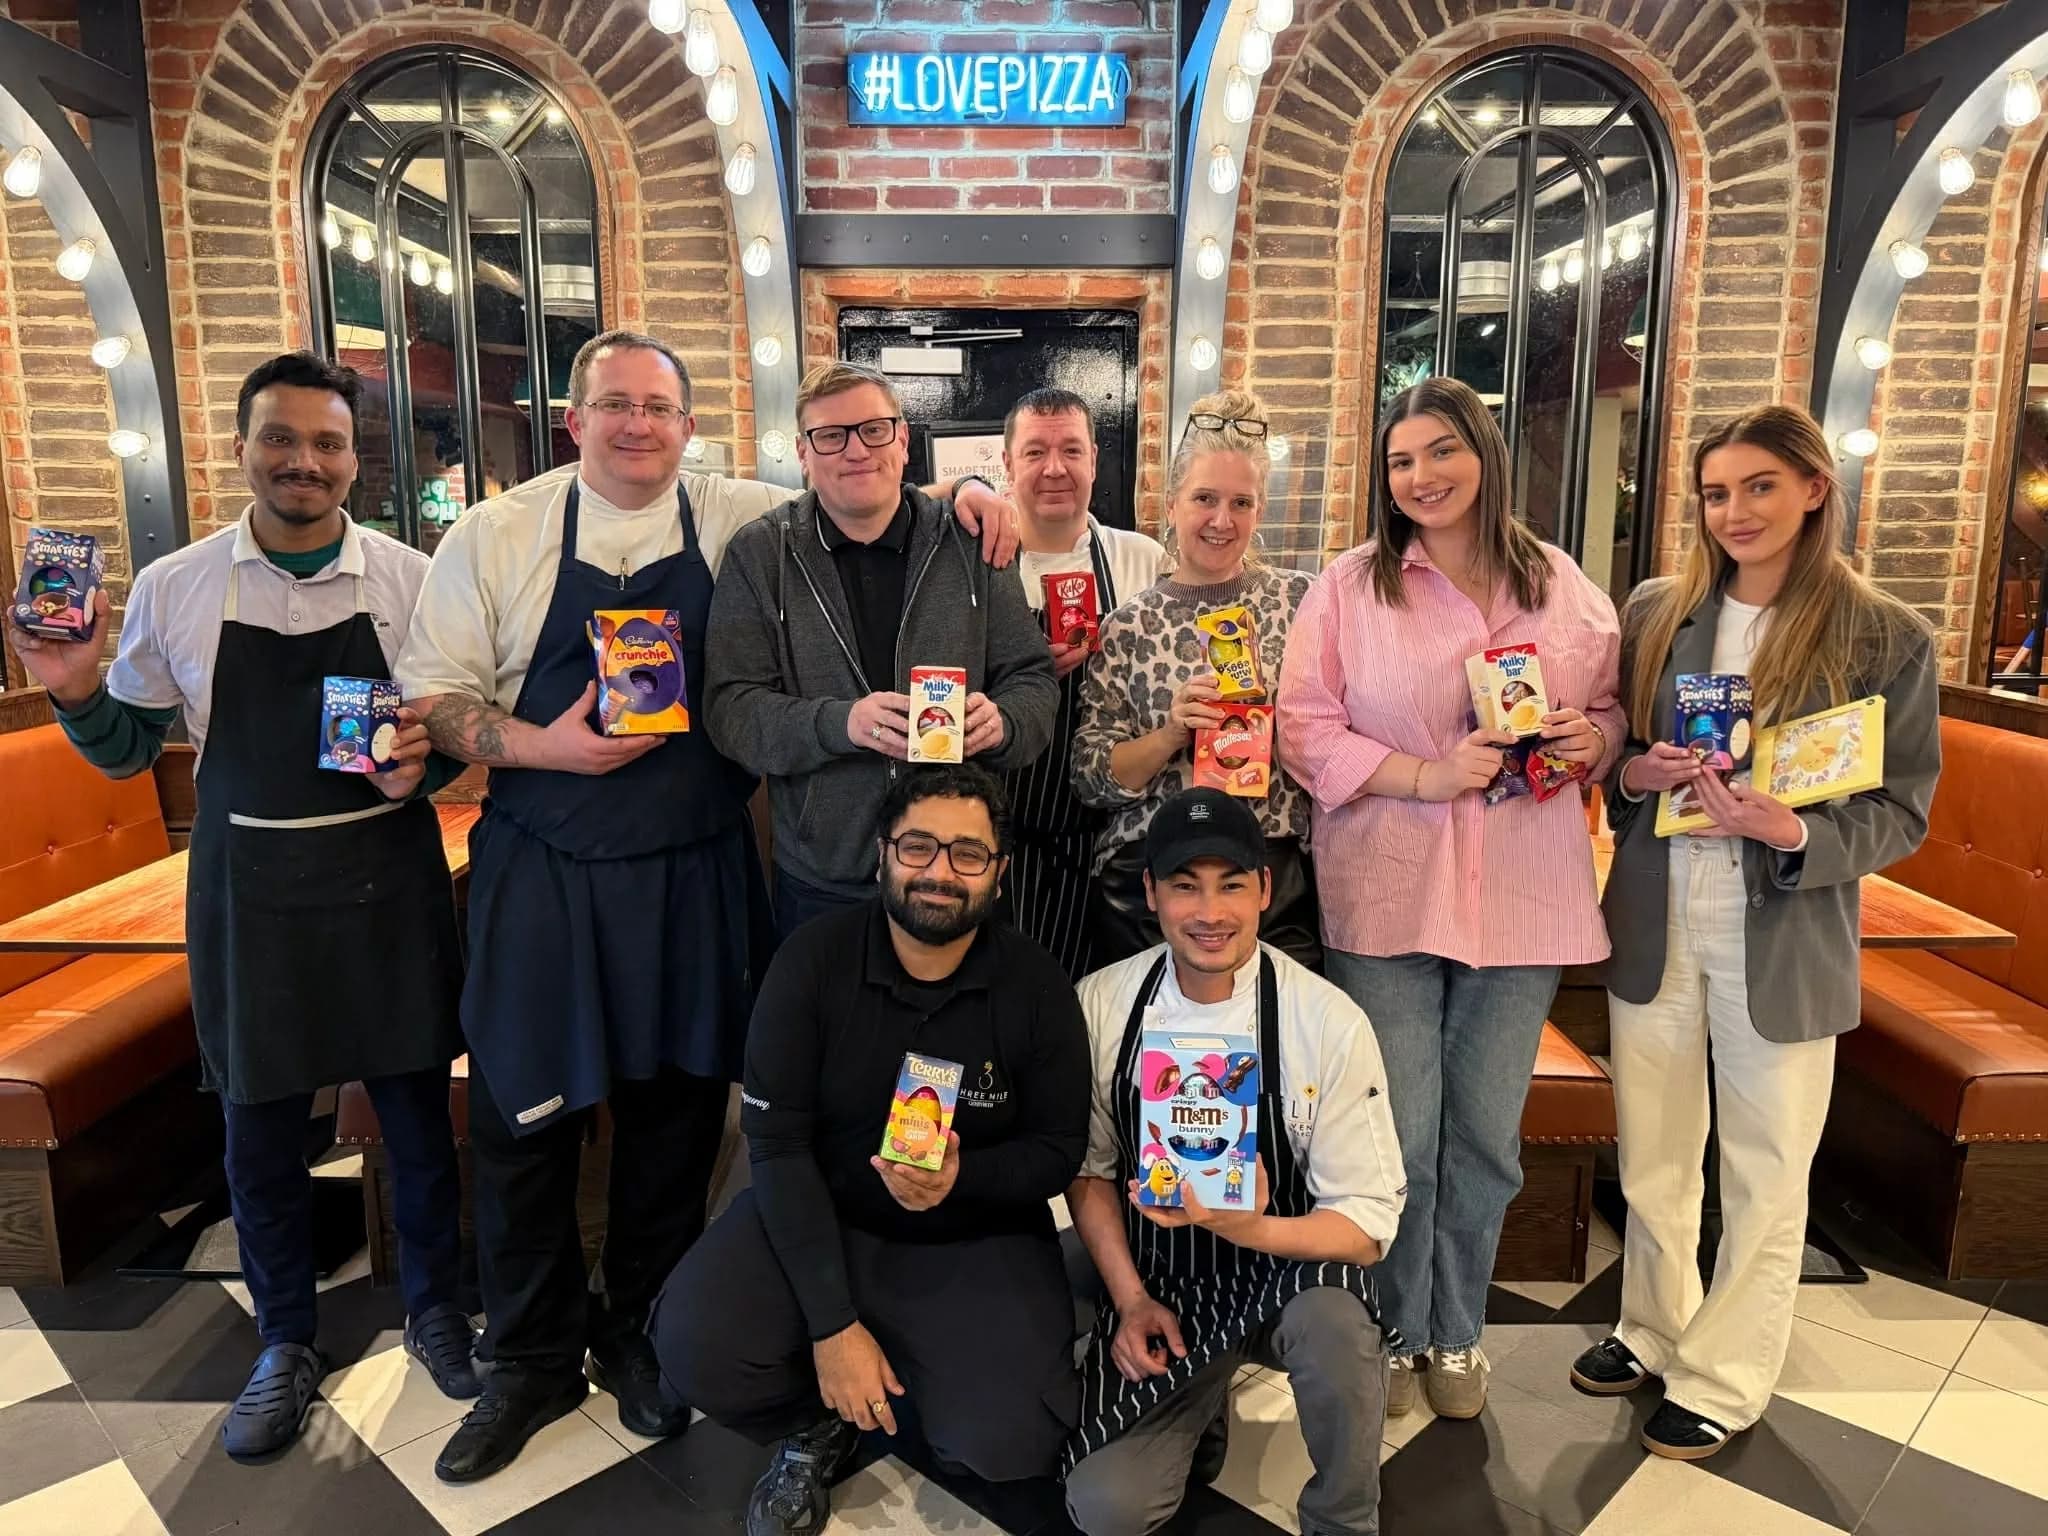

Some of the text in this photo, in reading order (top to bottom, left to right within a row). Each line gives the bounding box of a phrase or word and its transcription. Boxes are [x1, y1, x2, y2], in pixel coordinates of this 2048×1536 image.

[863, 54, 1115, 113] #LOVEPIZZA
[979, 465, 1002, 475] THE
[30, 541, 88, 558] SMARTIES
[614, 648, 668, 661] crunchie
[1498, 655, 1527, 669] Milky
[1505, 667, 1523, 677] bar
[923, 680, 954, 694] Milky
[326, 692, 368, 706] SMARTIES
[929, 691, 948, 702] bar
[1679, 687, 1725, 702] SMARTIES
[959, 1088, 1008, 1101] HREE MILE
[900, 1115, 930, 1130] minis
[1178, 1124, 1216, 1136] bunny
